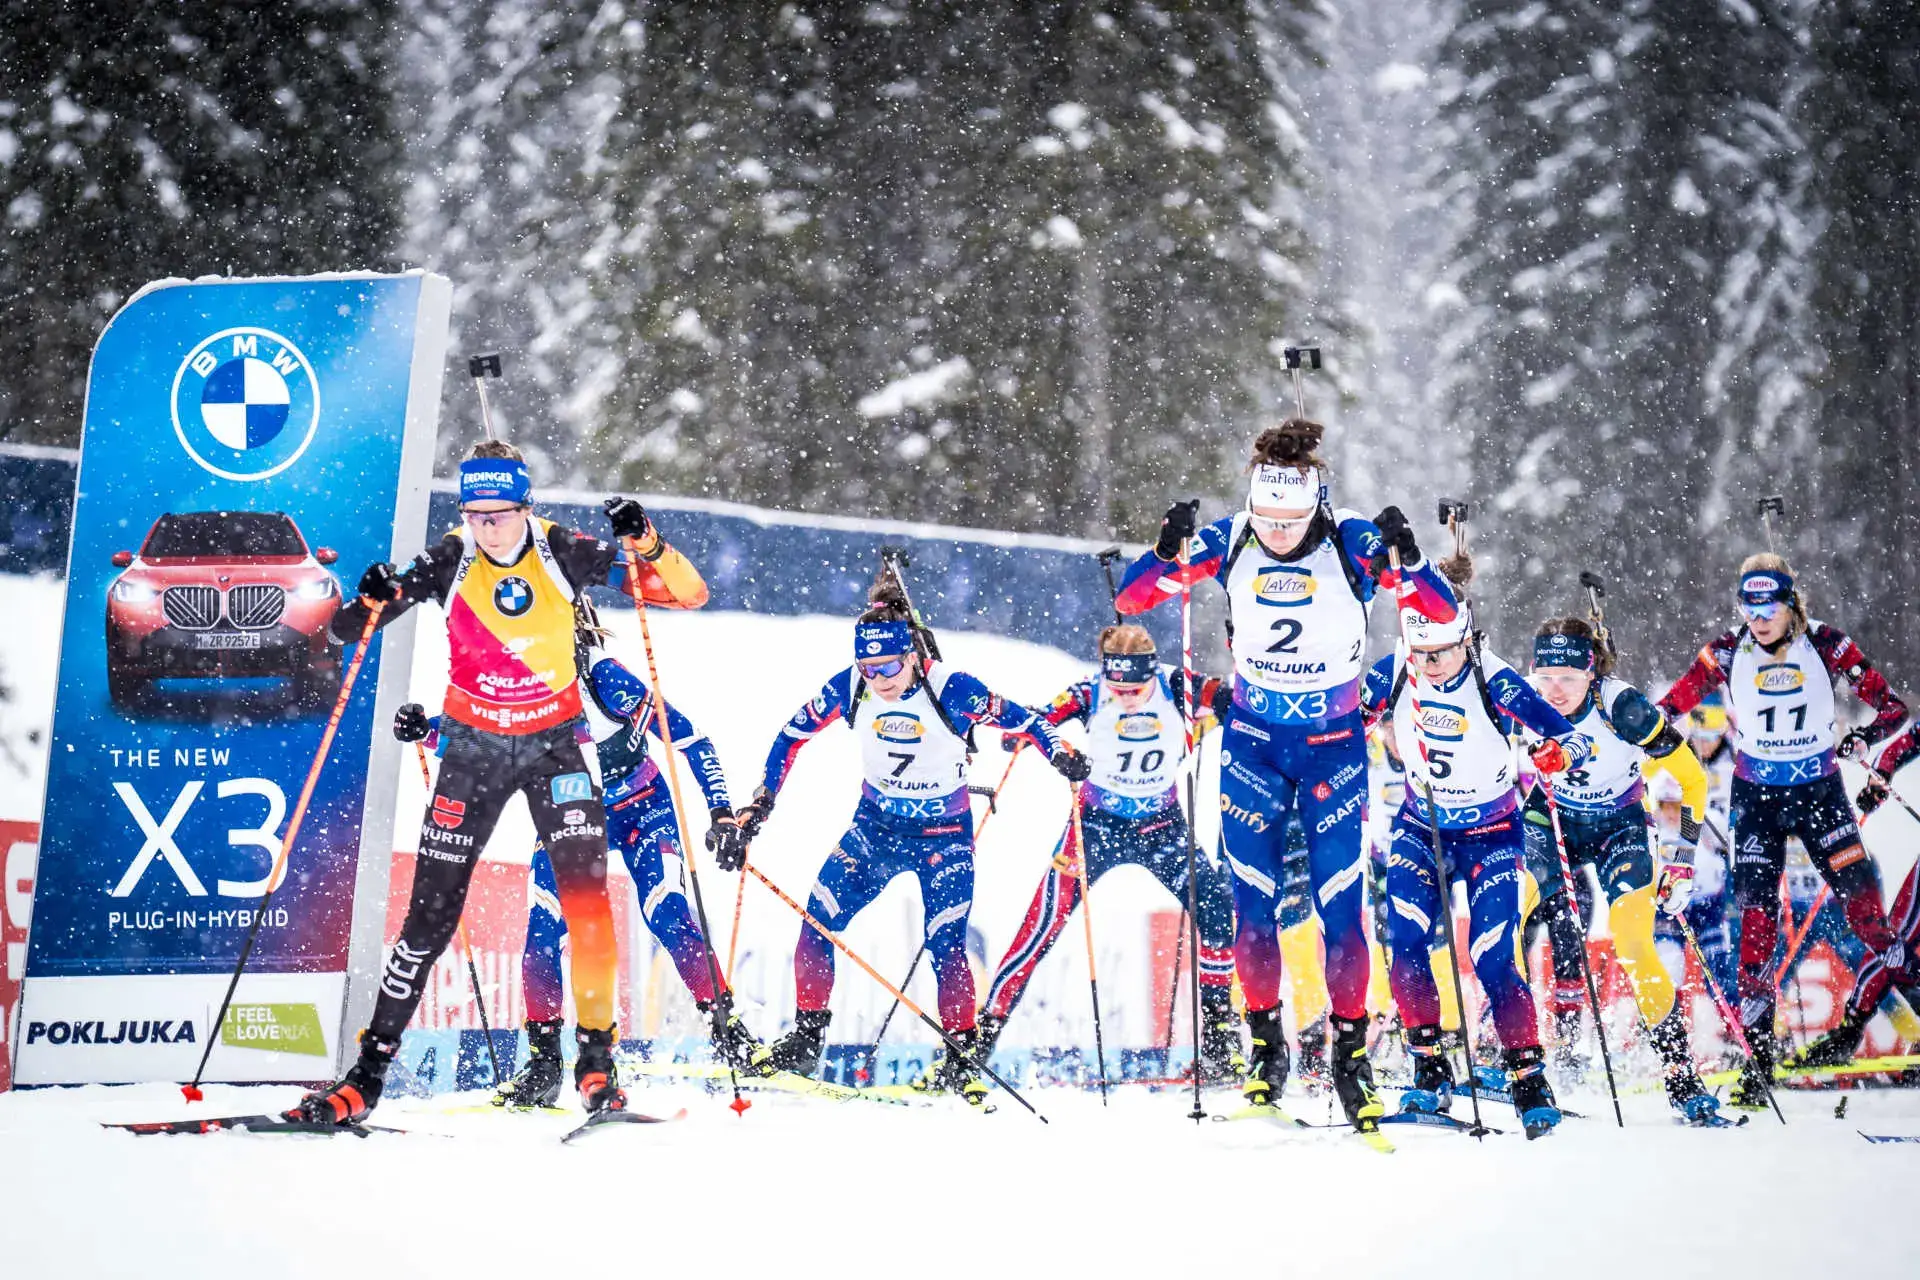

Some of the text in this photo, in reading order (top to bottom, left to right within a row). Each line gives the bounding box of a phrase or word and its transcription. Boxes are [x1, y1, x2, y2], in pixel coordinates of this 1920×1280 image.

[189, 334, 301, 378] BMW
[464, 472, 514, 485] ERDINGER
[496, 576, 528, 591] BMW
[1265, 618, 1303, 654] 2
[1349, 640, 1361, 662] 2
[476, 670, 555, 688] POKLJUKA
[1282, 691, 1328, 719] X3
[1757, 703, 1808, 733] 11
[110, 747, 231, 768] THE NEW
[888, 752, 915, 778] 7
[1117, 750, 1165, 773] 10
[1427, 748, 1454, 779] 5
[1789, 756, 1822, 783] X3
[1564, 769, 1590, 787] 8
[909, 800, 946, 818] X3
[1316, 794, 1362, 834] CRAFT
[110, 776, 289, 899] X3
[550, 822, 604, 842] tectake
[427, 849, 467, 864] TERREX
[1471, 872, 1512, 907] CRAFT
[109, 910, 289, 930] PLUG-IN-HYBRID
[381, 939, 431, 1000] GER
[236, 1007, 276, 1023] FEEL
[26, 1019, 196, 1045] POKLJUKA
[416, 1047, 438, 1084] 4
